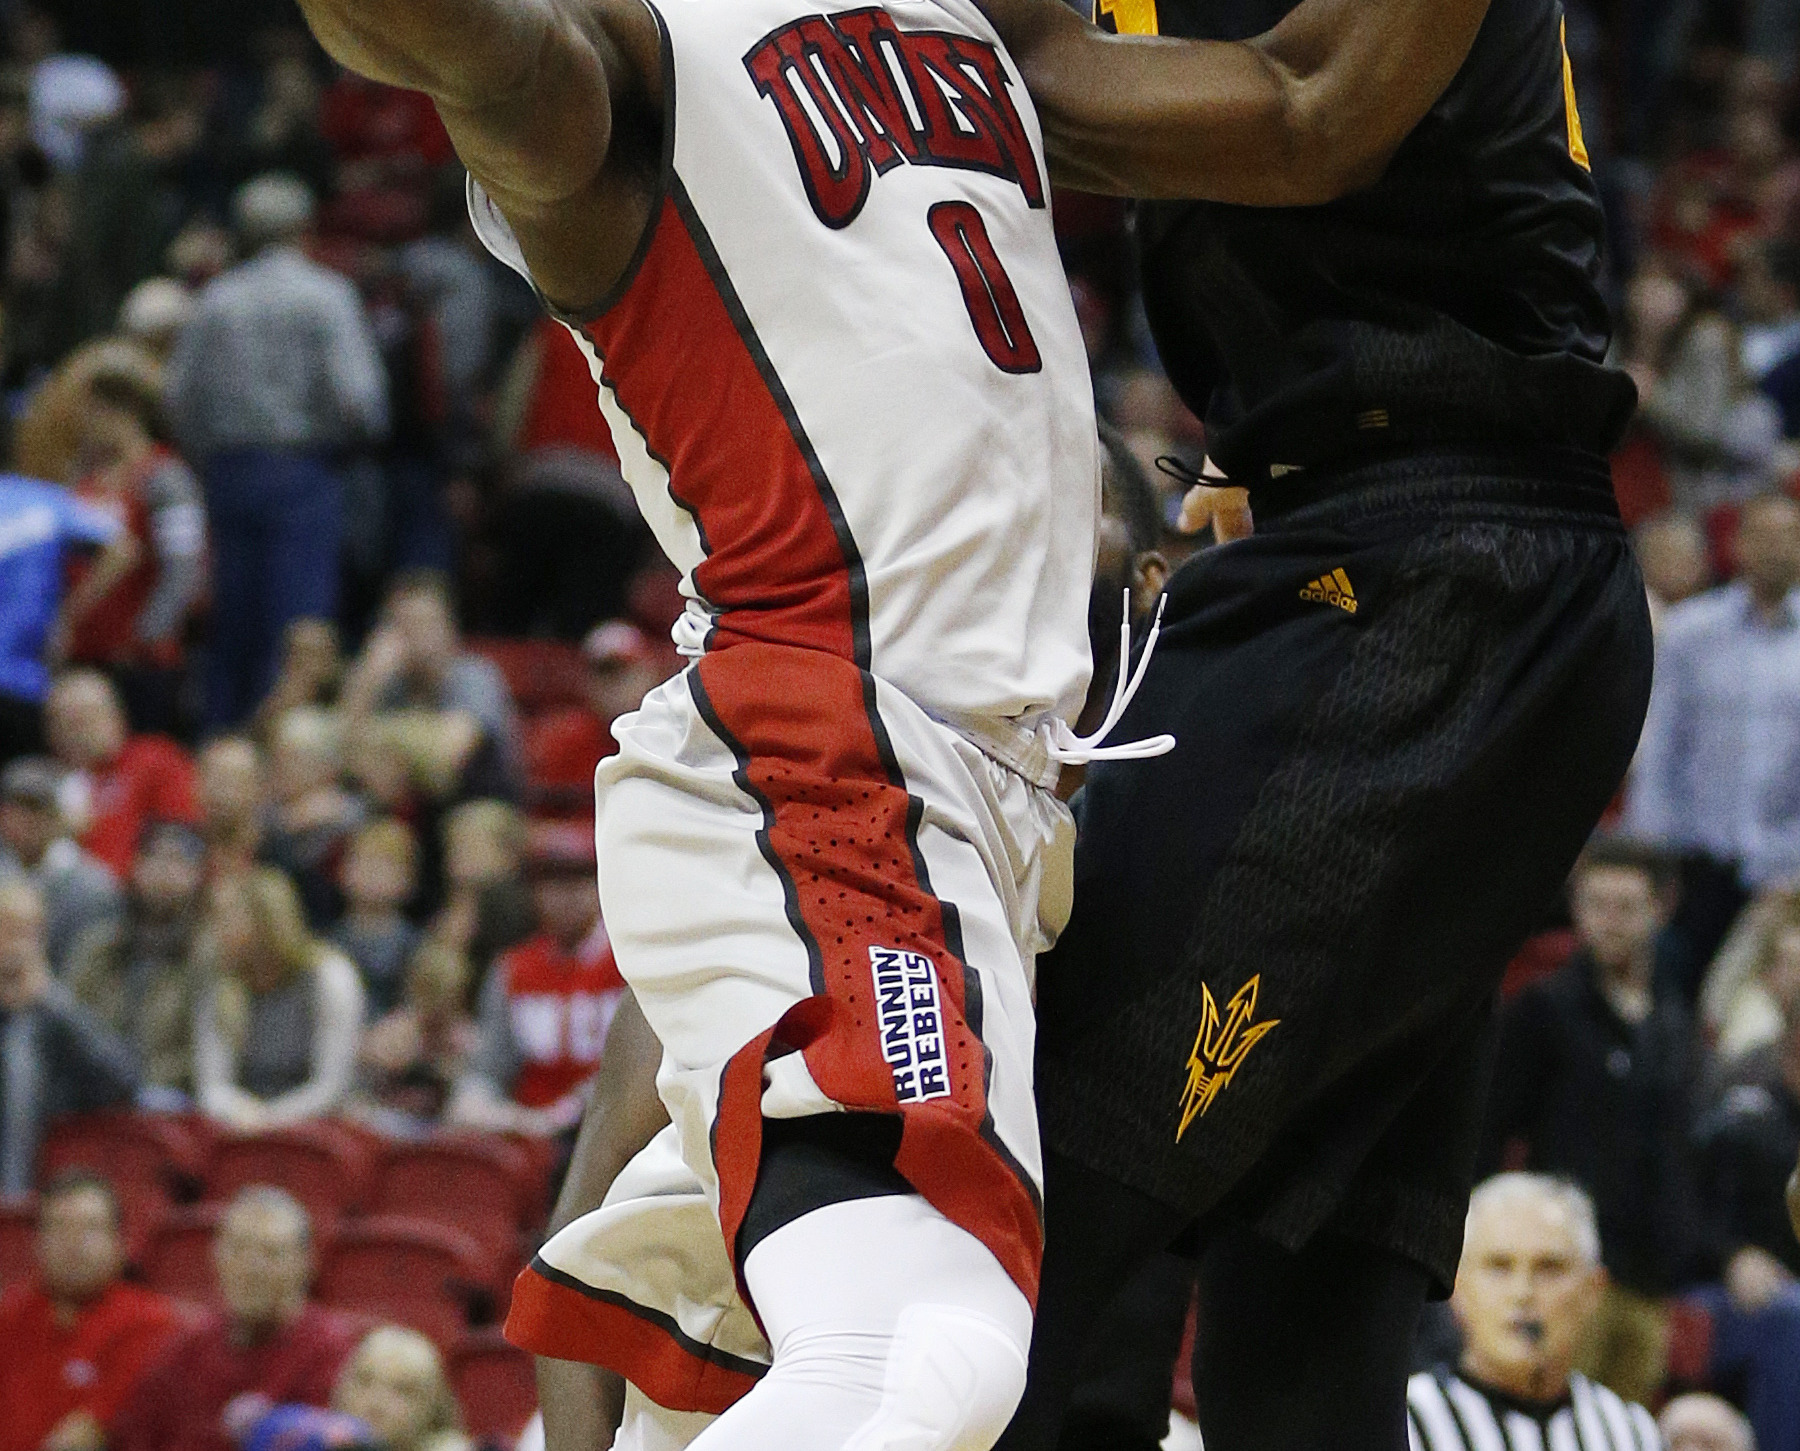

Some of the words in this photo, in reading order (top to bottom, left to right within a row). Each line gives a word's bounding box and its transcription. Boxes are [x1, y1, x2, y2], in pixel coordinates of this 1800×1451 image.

[742, 6, 1046, 230] UNLV
[927, 200, 1043, 374] 0
[1299, 588, 1358, 614] adidas
[904, 954, 946, 1096] REBELS
